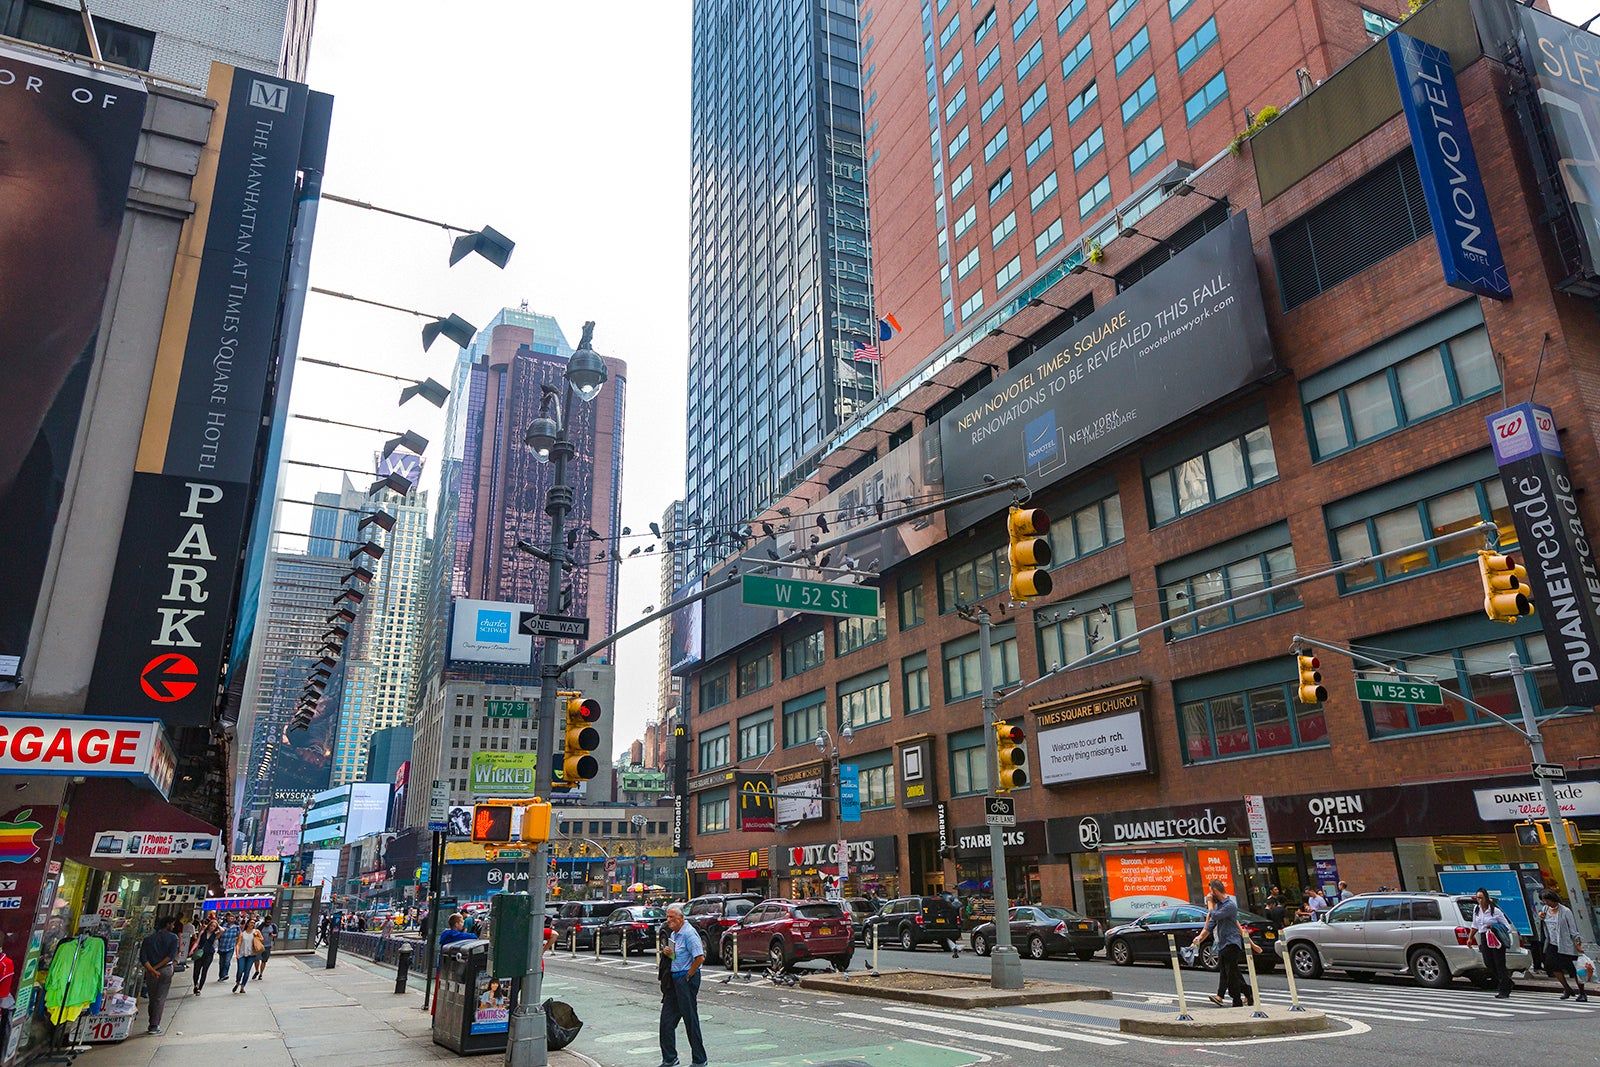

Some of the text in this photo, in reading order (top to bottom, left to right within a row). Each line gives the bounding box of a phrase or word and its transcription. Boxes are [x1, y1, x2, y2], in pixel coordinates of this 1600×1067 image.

[71, 87, 118, 109] OF
[1417, 64, 1488, 256] NOVOTEL
[1462, 250, 1490, 267] HOTEL
[198, 120, 273, 472] THE MANHATTAN AT TIMES SQUARE HOTEL
[1138, 294, 1235, 358] novotelnewyork.com
[971, 275, 1232, 445] RENOVATIONS TO BE REVEALED THIS FALL.
[957, 310, 1131, 433] NEW NOVOTEL TIMES SQUARE.
[1069, 408, 1121, 445] NEW YORK
[1082, 408, 1138, 446] TIMES SQUARE
[1028, 440, 1056, 459] NOVOTEL
[151, 482, 223, 647] PARK
[776, 583, 848, 609] W 52 St
[480, 618, 508, 628] charles
[530, 620, 581, 633] ONE WAY
[1372, 685, 1426, 700] W 52 St
[490, 702, 526, 716] W 52 ST
[1037, 695, 1138, 727] TIMES SQUARE CHURCH
[1051, 755, 1061, 764] The
[1063, 753, 1074, 763] only
[1075, 751, 1090, 760] thing
[1090, 747, 1114, 757] missing
[1115, 745, 1120, 753] is
[1052, 741, 1079, 752] Welcome
[1086, 738, 1096, 746] our
[1308, 795, 1363, 816] OPEN
[1509, 807, 1518, 815] by
[987, 815, 1014, 824] BIKE LANE
[1314, 815, 1366, 834] 24hrs
[147, 834, 167, 844] Phone
[167, 834, 173, 844] 5
[960, 831, 1025, 849] STARBCKS
[788, 847, 794, 867] I
[804, 845, 826, 865] NY
[828, 841, 875, 864] GFTS
[227, 875, 264, 889] ROCK
